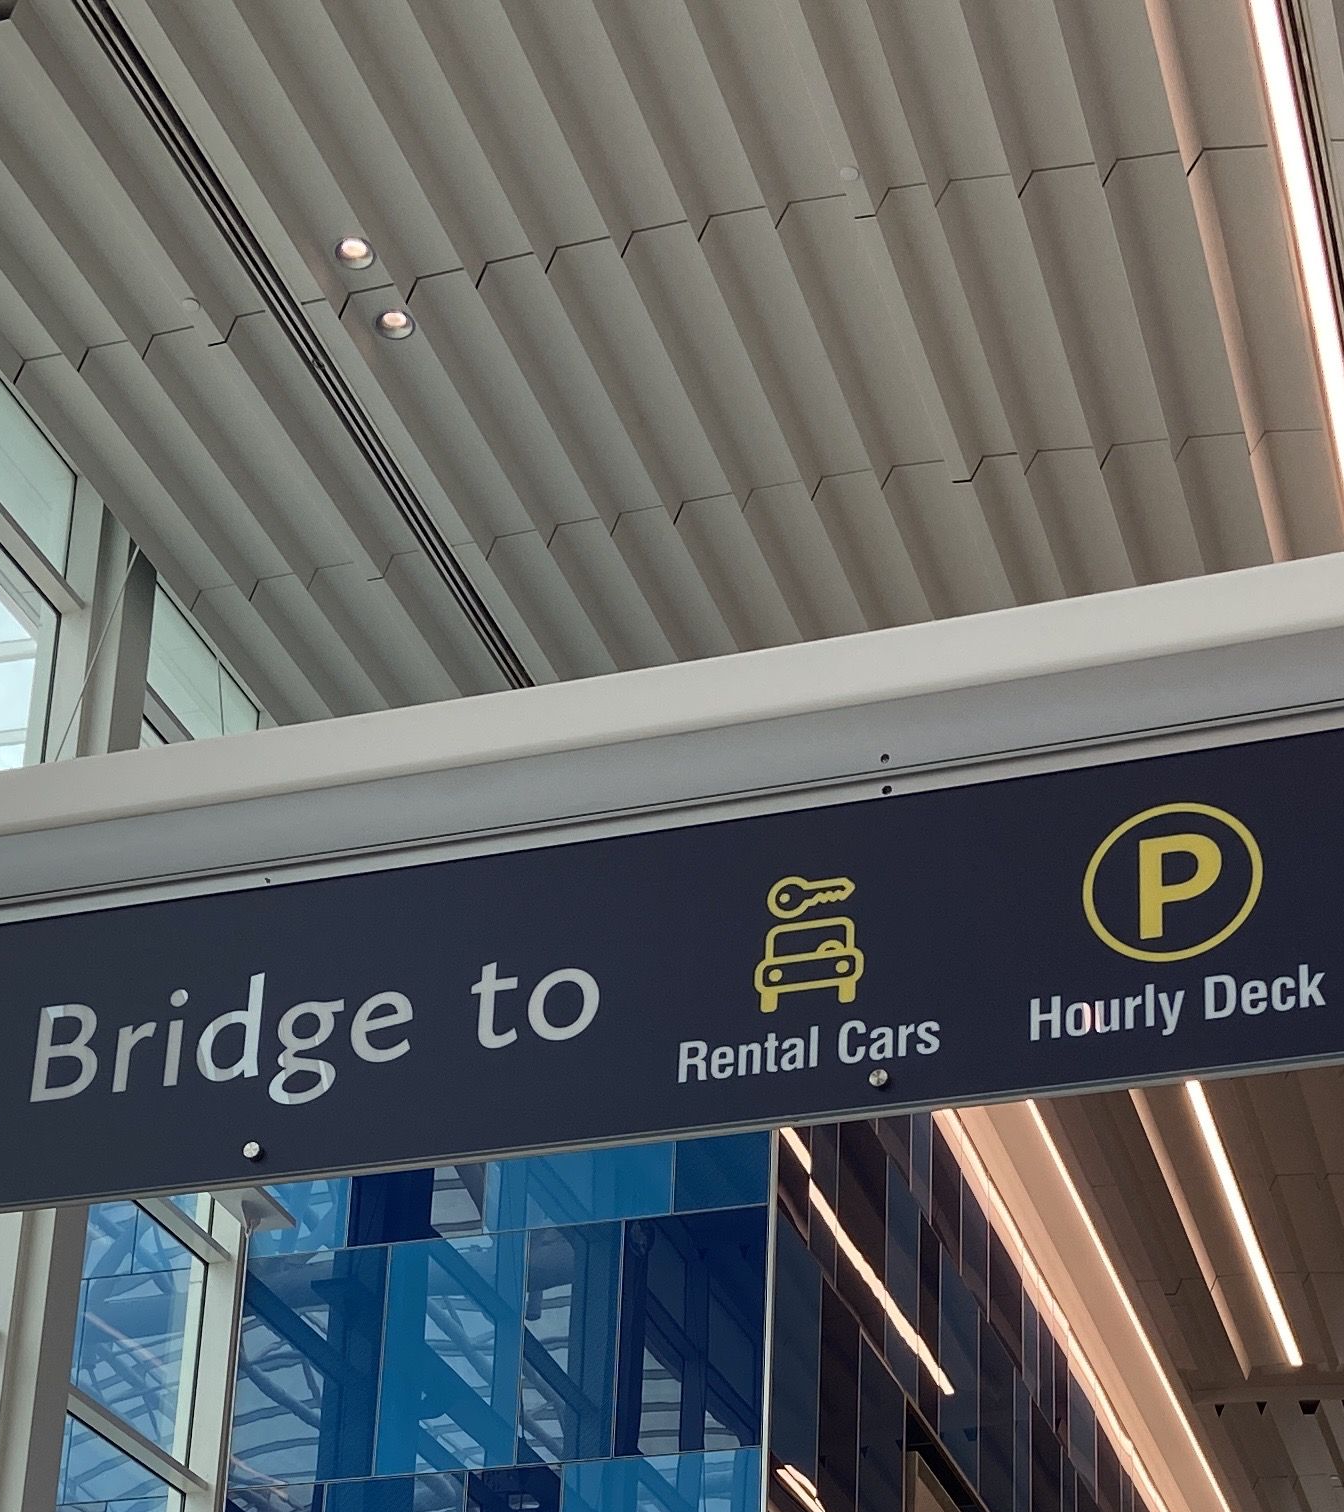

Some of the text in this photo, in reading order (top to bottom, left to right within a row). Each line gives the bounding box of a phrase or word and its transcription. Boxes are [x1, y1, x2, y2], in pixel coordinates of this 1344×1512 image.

[1138, 833, 1223, 941] P
[29, 961, 600, 1105] Bridge to
[1029, 964, 1327, 1042] Hourly Deck
[677, 1020, 941, 1084] Rental Cars
